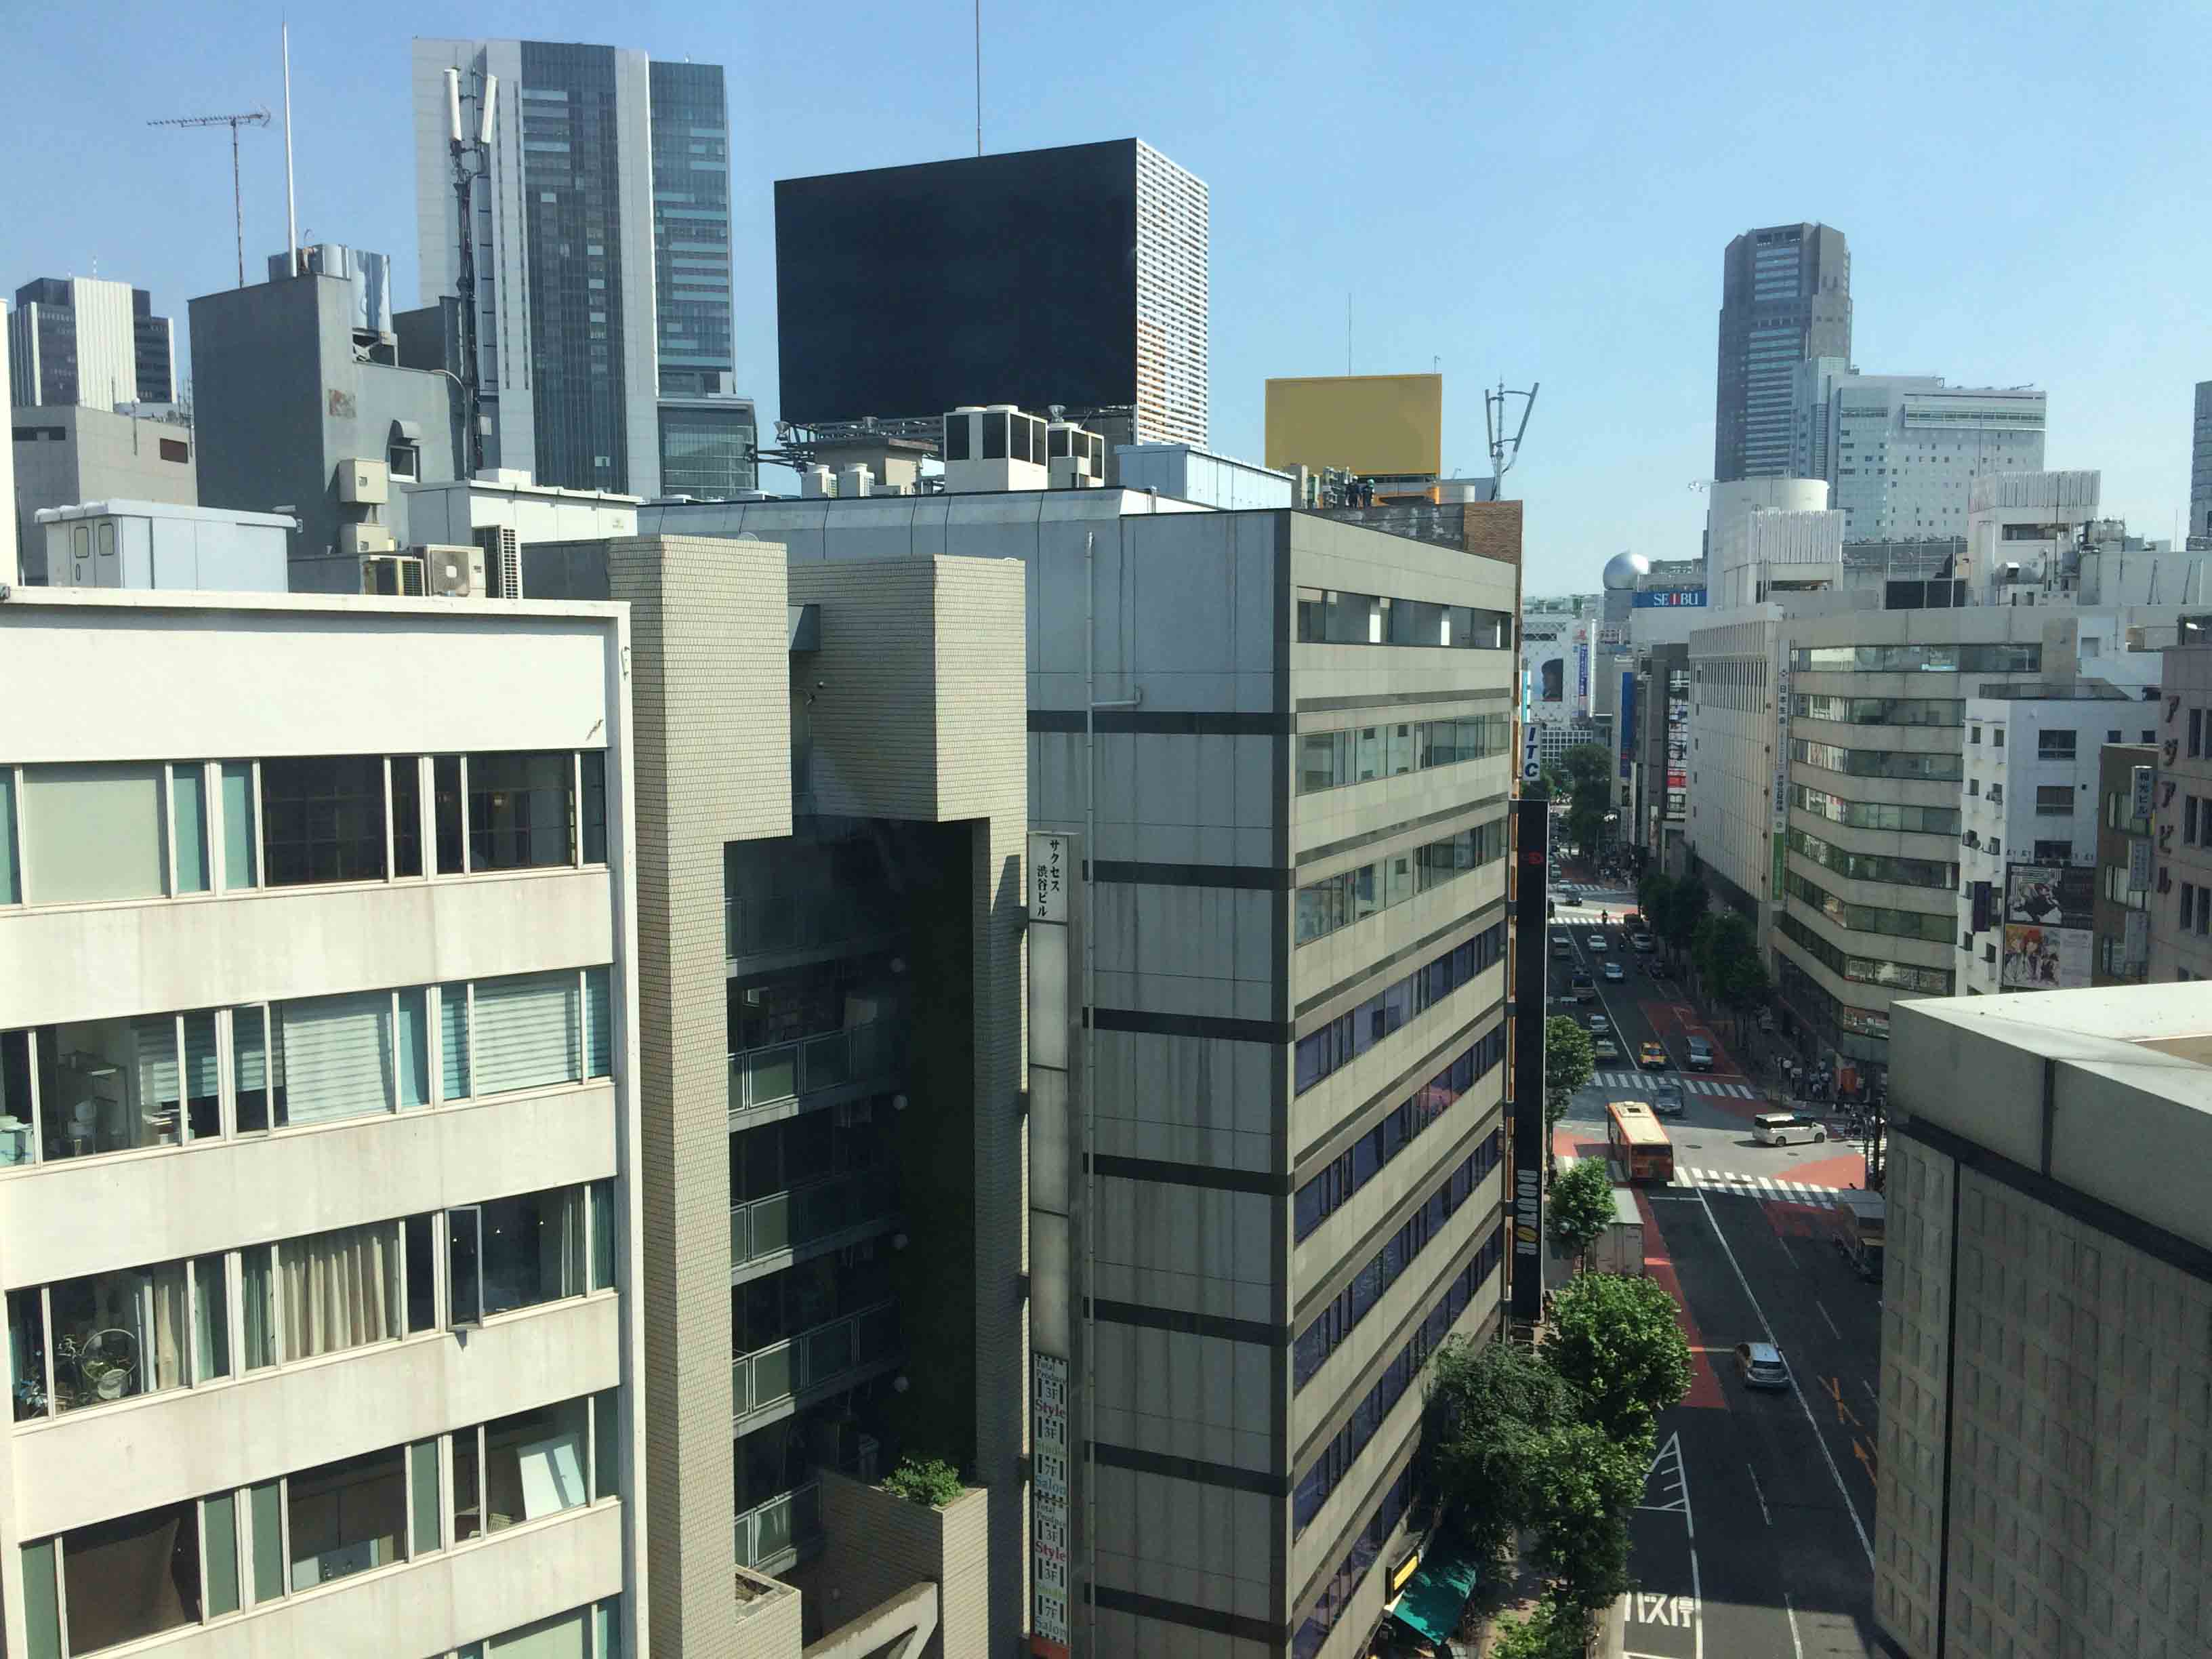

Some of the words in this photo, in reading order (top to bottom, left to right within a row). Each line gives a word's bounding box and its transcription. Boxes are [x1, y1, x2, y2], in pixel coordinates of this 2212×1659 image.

[1654, 592, 1698, 606] SEIBU
[1525, 726, 1539, 777] ITC
[1050, 840, 1060, 892] サクセス
[1037, 864, 1048, 917] 渋谷ビル
[1046, 1387, 1058, 1399] 3F
[1036, 1398, 1066, 1418] Style
[1044, 1427, 1057, 1439] 3F
[1044, 1464, 1057, 1477] 7F
[1036, 1475, 1067, 1495] Salon
[1046, 1530, 1058, 1542] 3F
[1036, 1540, 1066, 1561] Style
[1044, 1568, 1057, 1582] 3F
[1045, 1606, 1057, 1618] 7F
[1624, 1591, 1695, 1628] バス停
[1036, 1616, 1067, 1637] Salon
